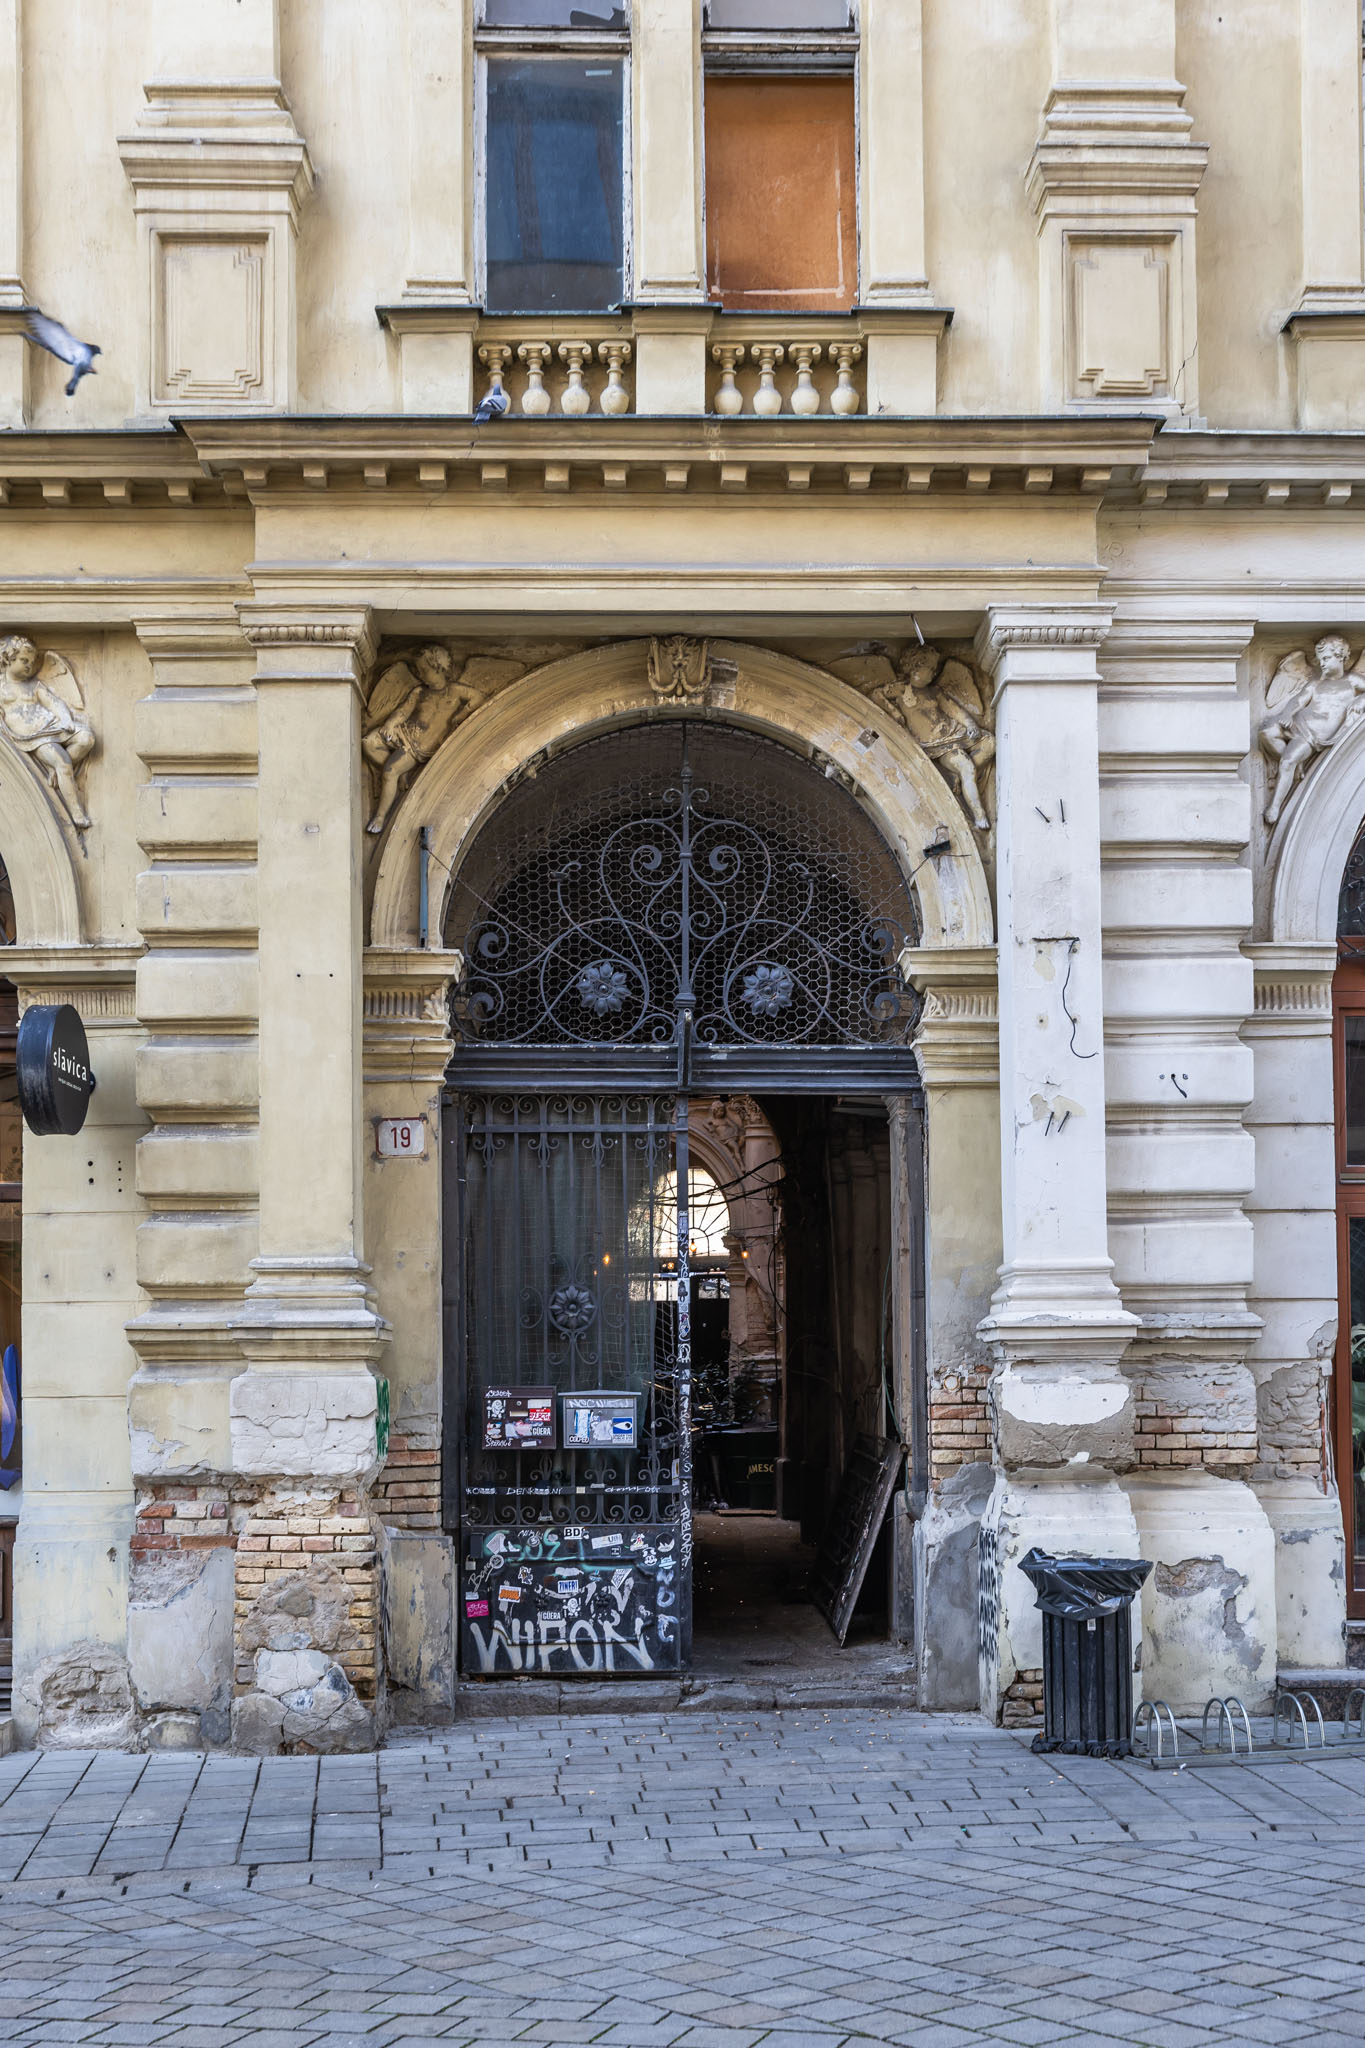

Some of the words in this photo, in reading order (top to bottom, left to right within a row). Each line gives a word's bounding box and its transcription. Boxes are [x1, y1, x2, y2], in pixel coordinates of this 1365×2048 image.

[391, 1127, 411, 1149] 19
[532, 1426, 551, 1436] GÜERA
[542, 1611, 561, 1620] GÜERA
